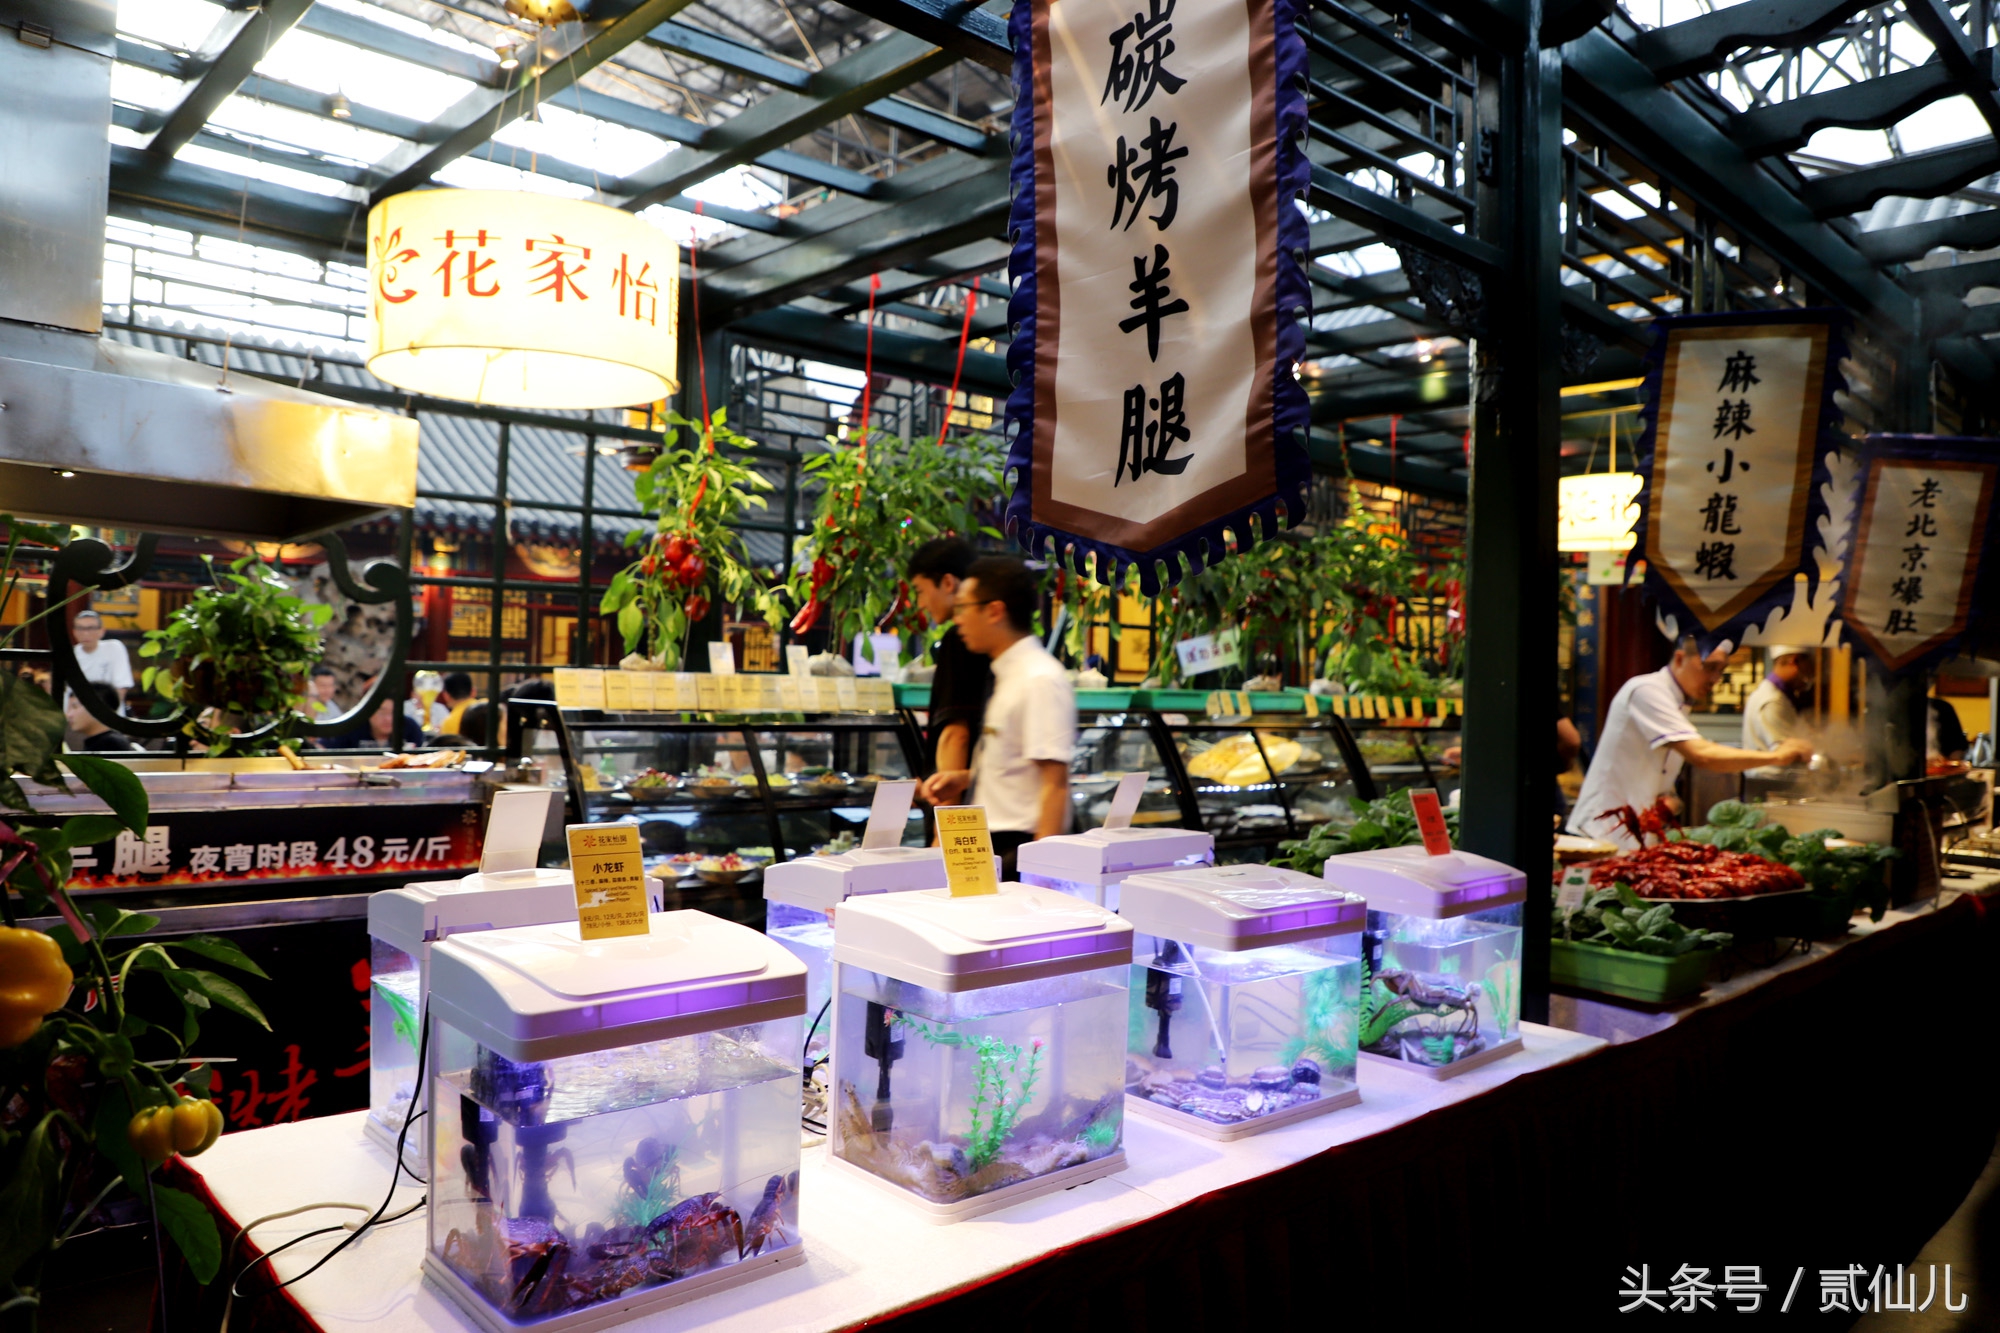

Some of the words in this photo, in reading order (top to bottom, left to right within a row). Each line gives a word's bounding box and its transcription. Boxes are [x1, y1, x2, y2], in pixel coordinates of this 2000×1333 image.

[432, 229, 680, 336] 花家怡
[1100, 0, 1195, 488] 碳烤羊腿
[1694, 350, 1761, 582] 麻辣小龍蝦
[1883, 477, 1943, 635] 老北京爆肚
[592, 862, 625, 874] 小龙虾
